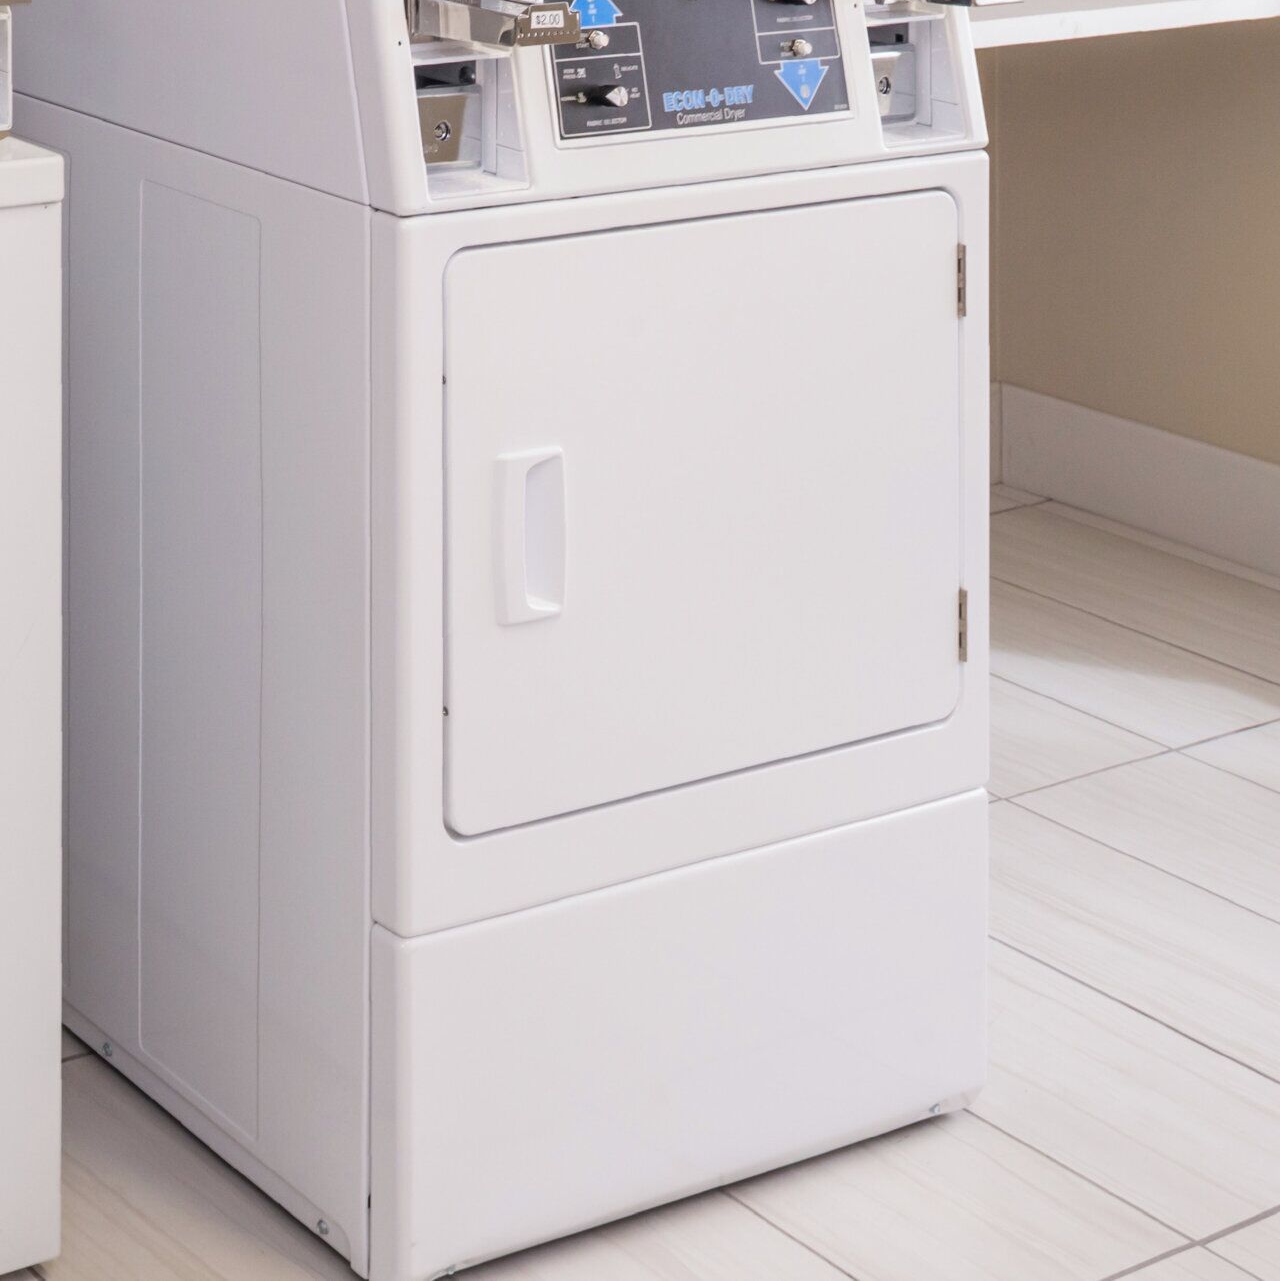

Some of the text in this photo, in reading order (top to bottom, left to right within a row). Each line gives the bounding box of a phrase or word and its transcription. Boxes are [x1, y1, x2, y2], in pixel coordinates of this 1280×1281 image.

[535, 14, 561, 25] $2.00
[662, 84, 754, 112] ECON-O-DRY
[676, 107, 746, 125] Commercial Dryer
